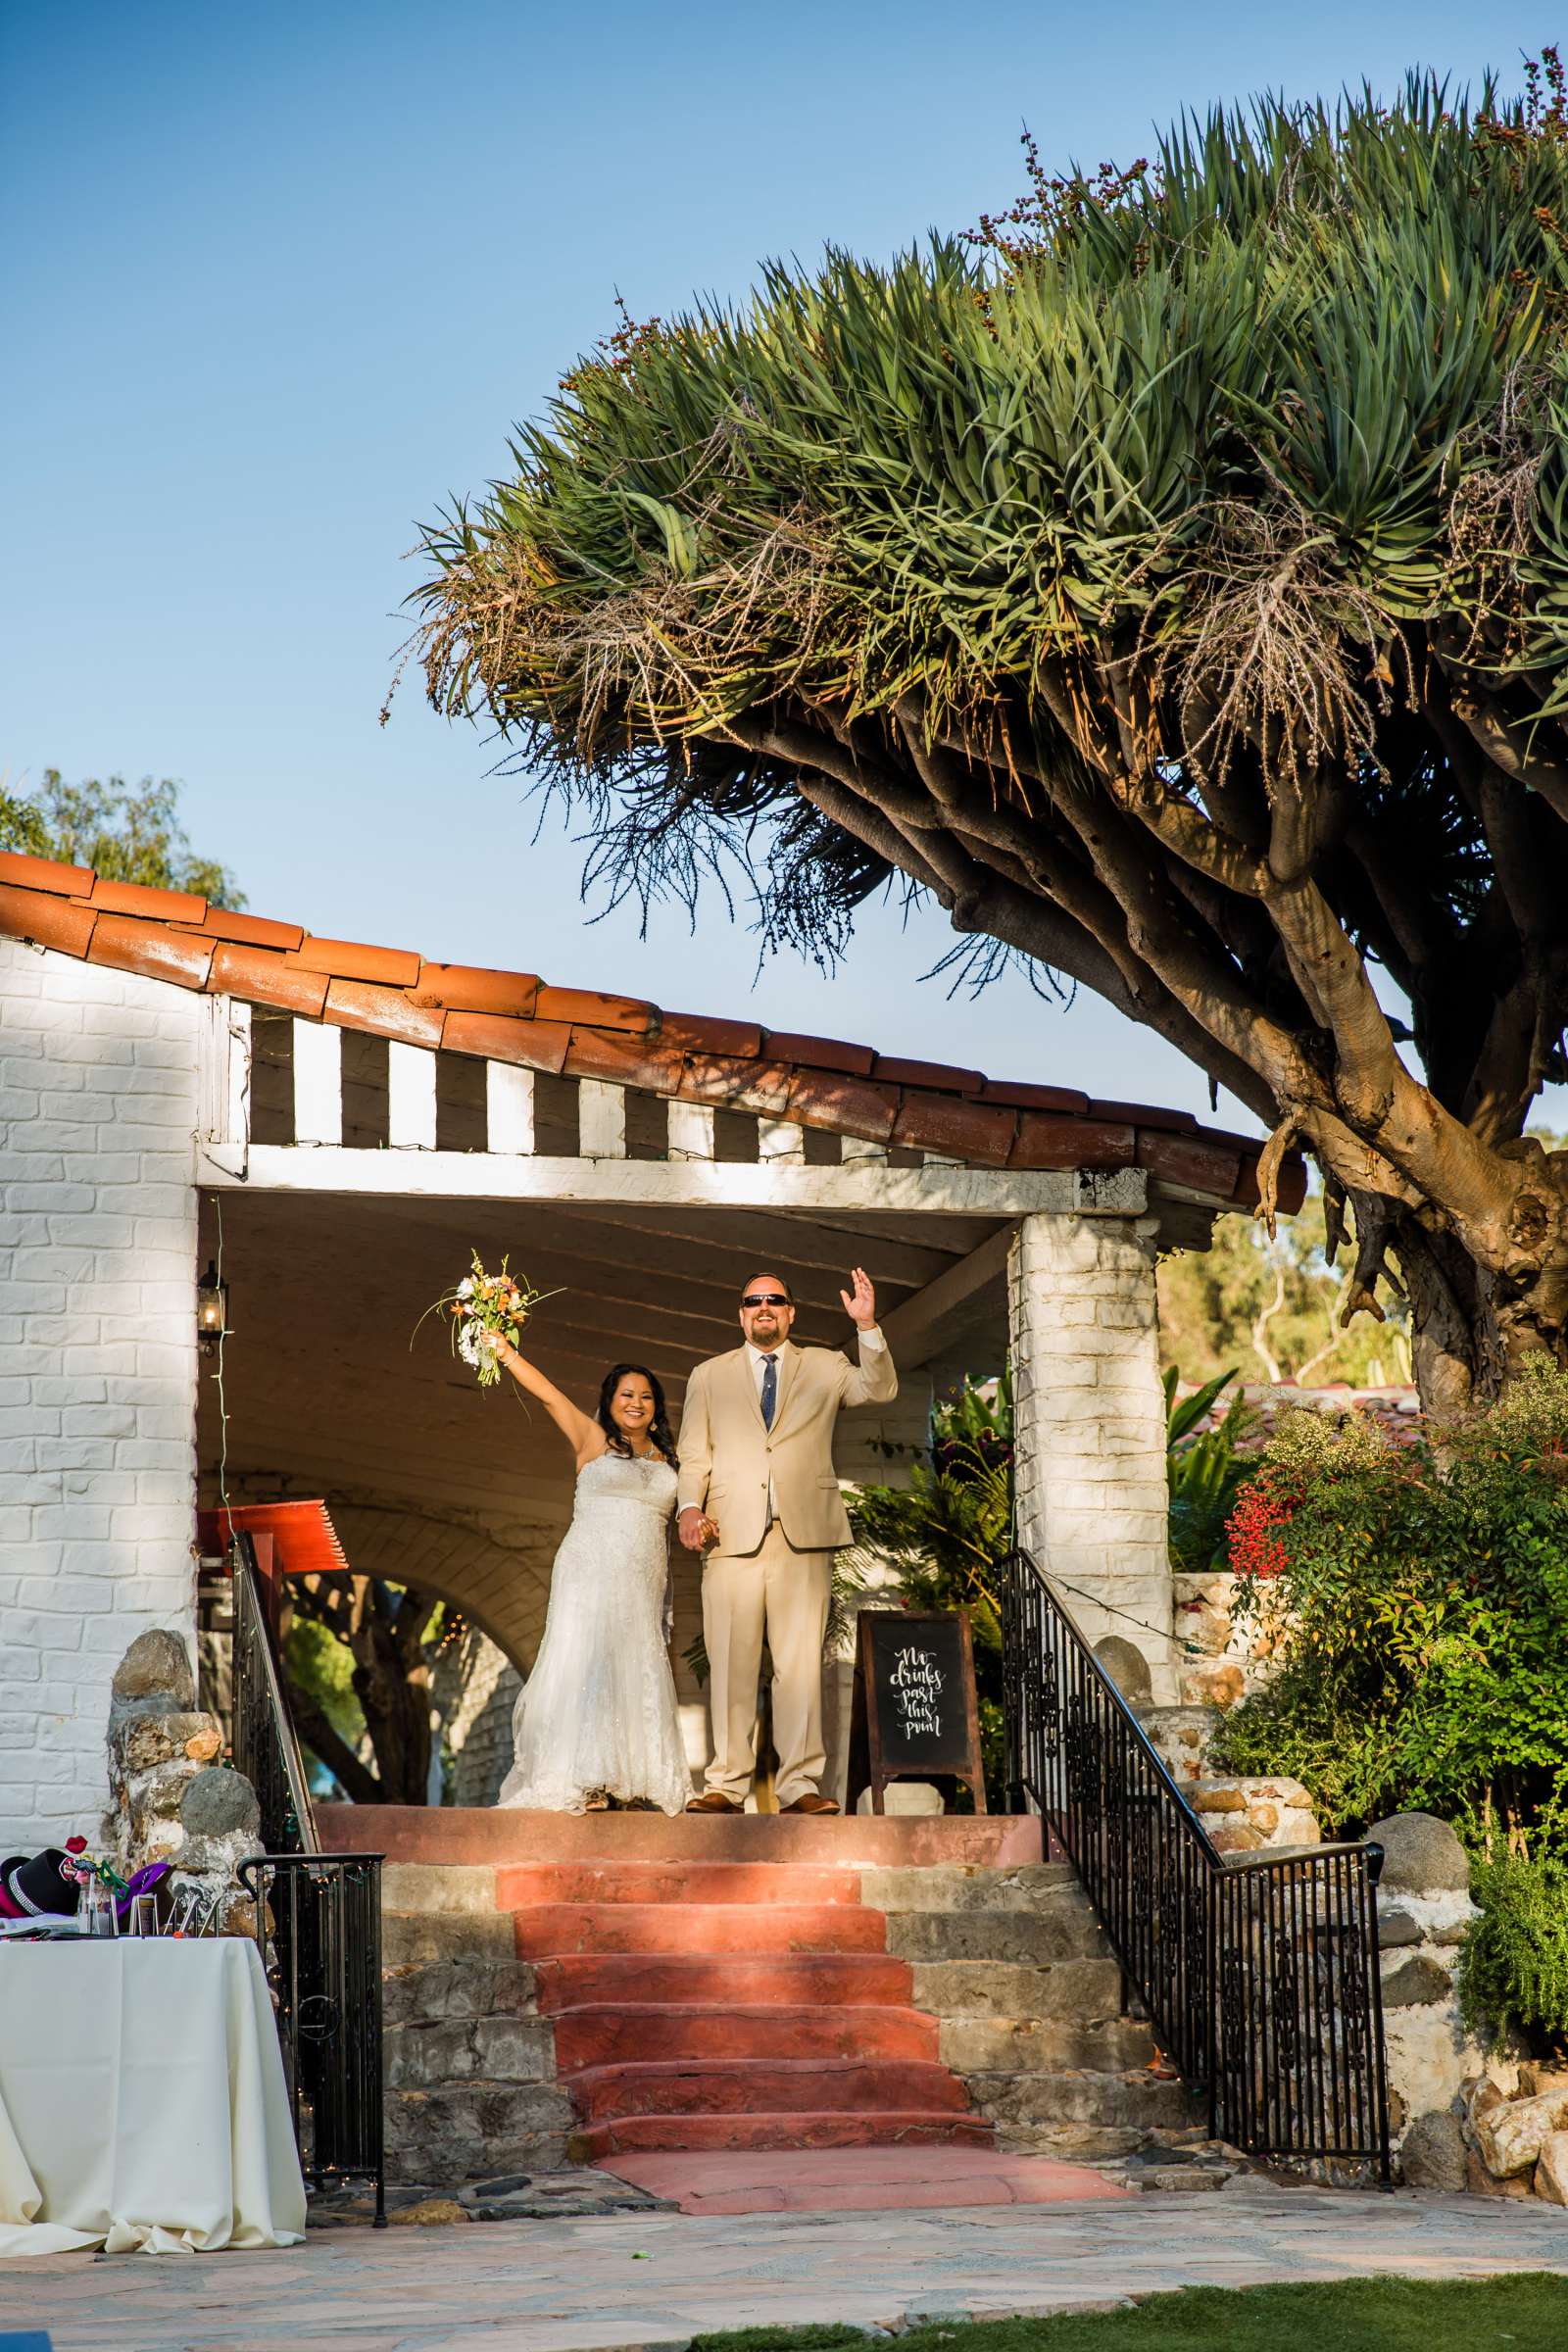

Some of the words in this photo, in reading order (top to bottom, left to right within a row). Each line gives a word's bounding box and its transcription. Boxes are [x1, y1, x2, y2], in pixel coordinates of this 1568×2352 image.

[894, 1646, 937, 1666] No
[890, 1660, 947, 1690] drinks
[894, 1686, 943, 1710] past
[897, 1699, 938, 1722] this
[897, 1715, 943, 1740] point
